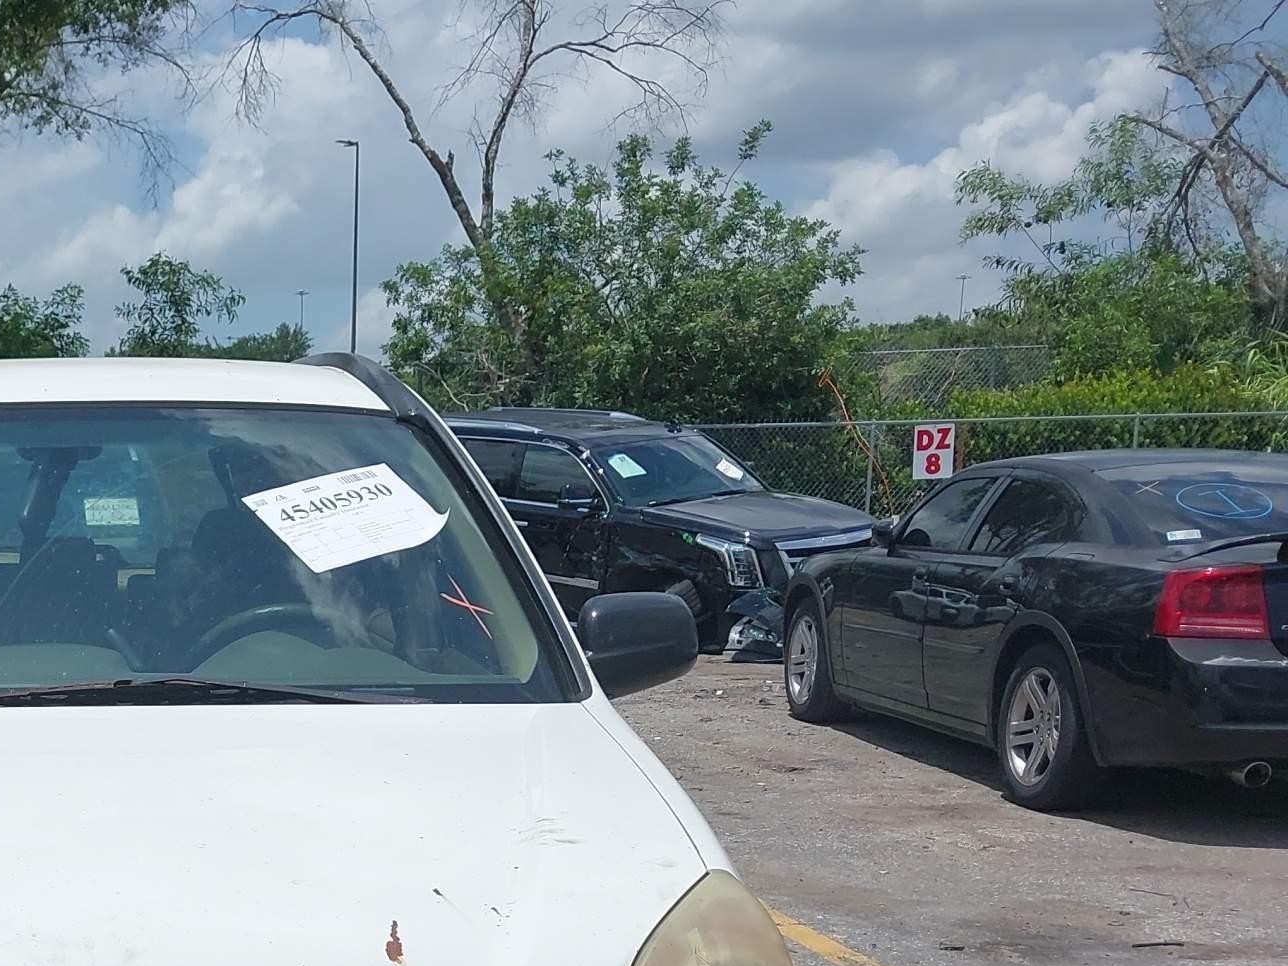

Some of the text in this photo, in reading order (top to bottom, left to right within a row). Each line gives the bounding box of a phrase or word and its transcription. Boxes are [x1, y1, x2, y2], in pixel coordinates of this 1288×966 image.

[916, 427, 952, 451] DZ
[925, 453, 941, 474] 8
[280, 482, 393, 523] 45405930
